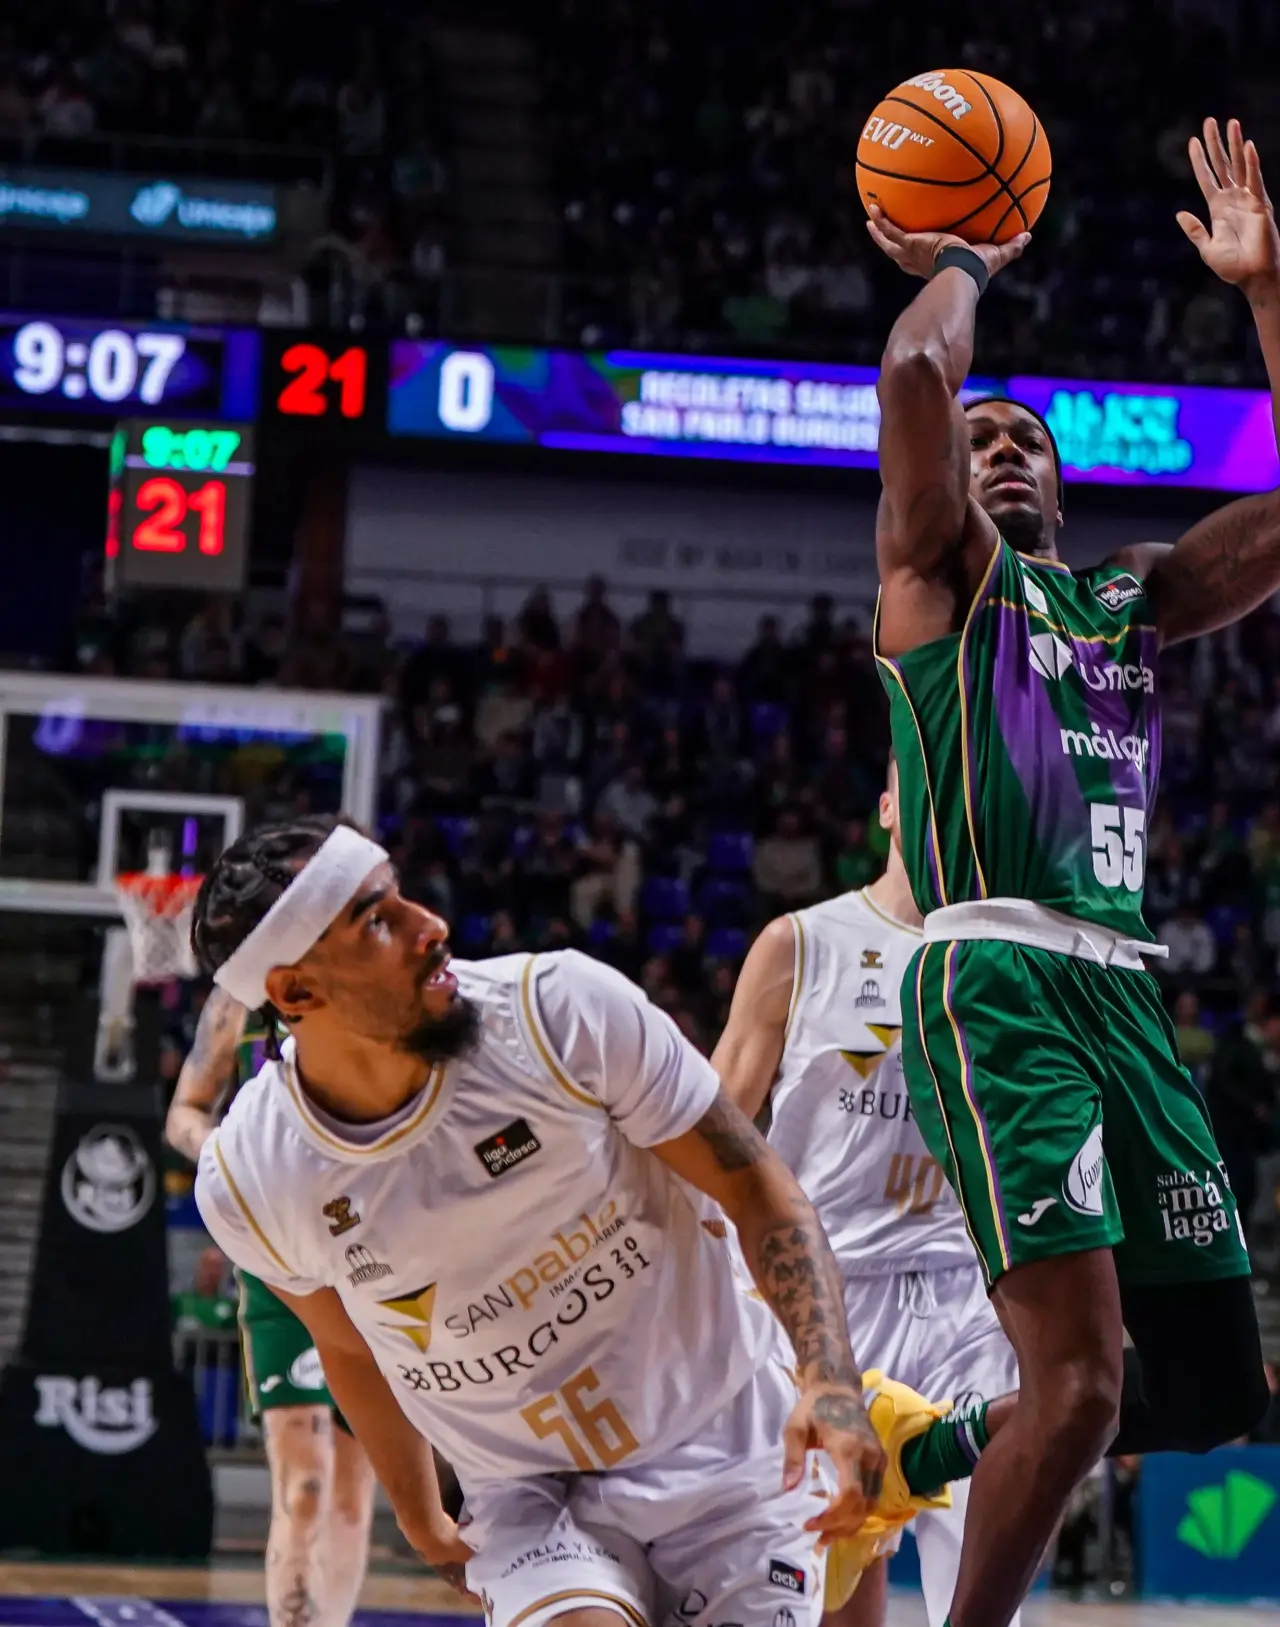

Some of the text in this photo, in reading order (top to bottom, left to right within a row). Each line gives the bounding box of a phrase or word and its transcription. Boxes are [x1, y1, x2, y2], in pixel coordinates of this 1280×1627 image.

[909, 132, 935, 147] NXT
[13, 322, 186, 404] 9:07
[277, 343, 367, 418] 21
[437, 351, 495, 432] 0
[142, 426, 240, 472] 9:07
[132, 476, 227, 555] 21
[1090, 802, 1145, 893] 55
[1161, 1208, 1230, 1246] laga
[426, 1264, 615, 1392] BURGOS
[34, 1375, 160, 1455] Risi
[519, 1365, 640, 1471] 56
[771, 1570, 799, 1590] acb
